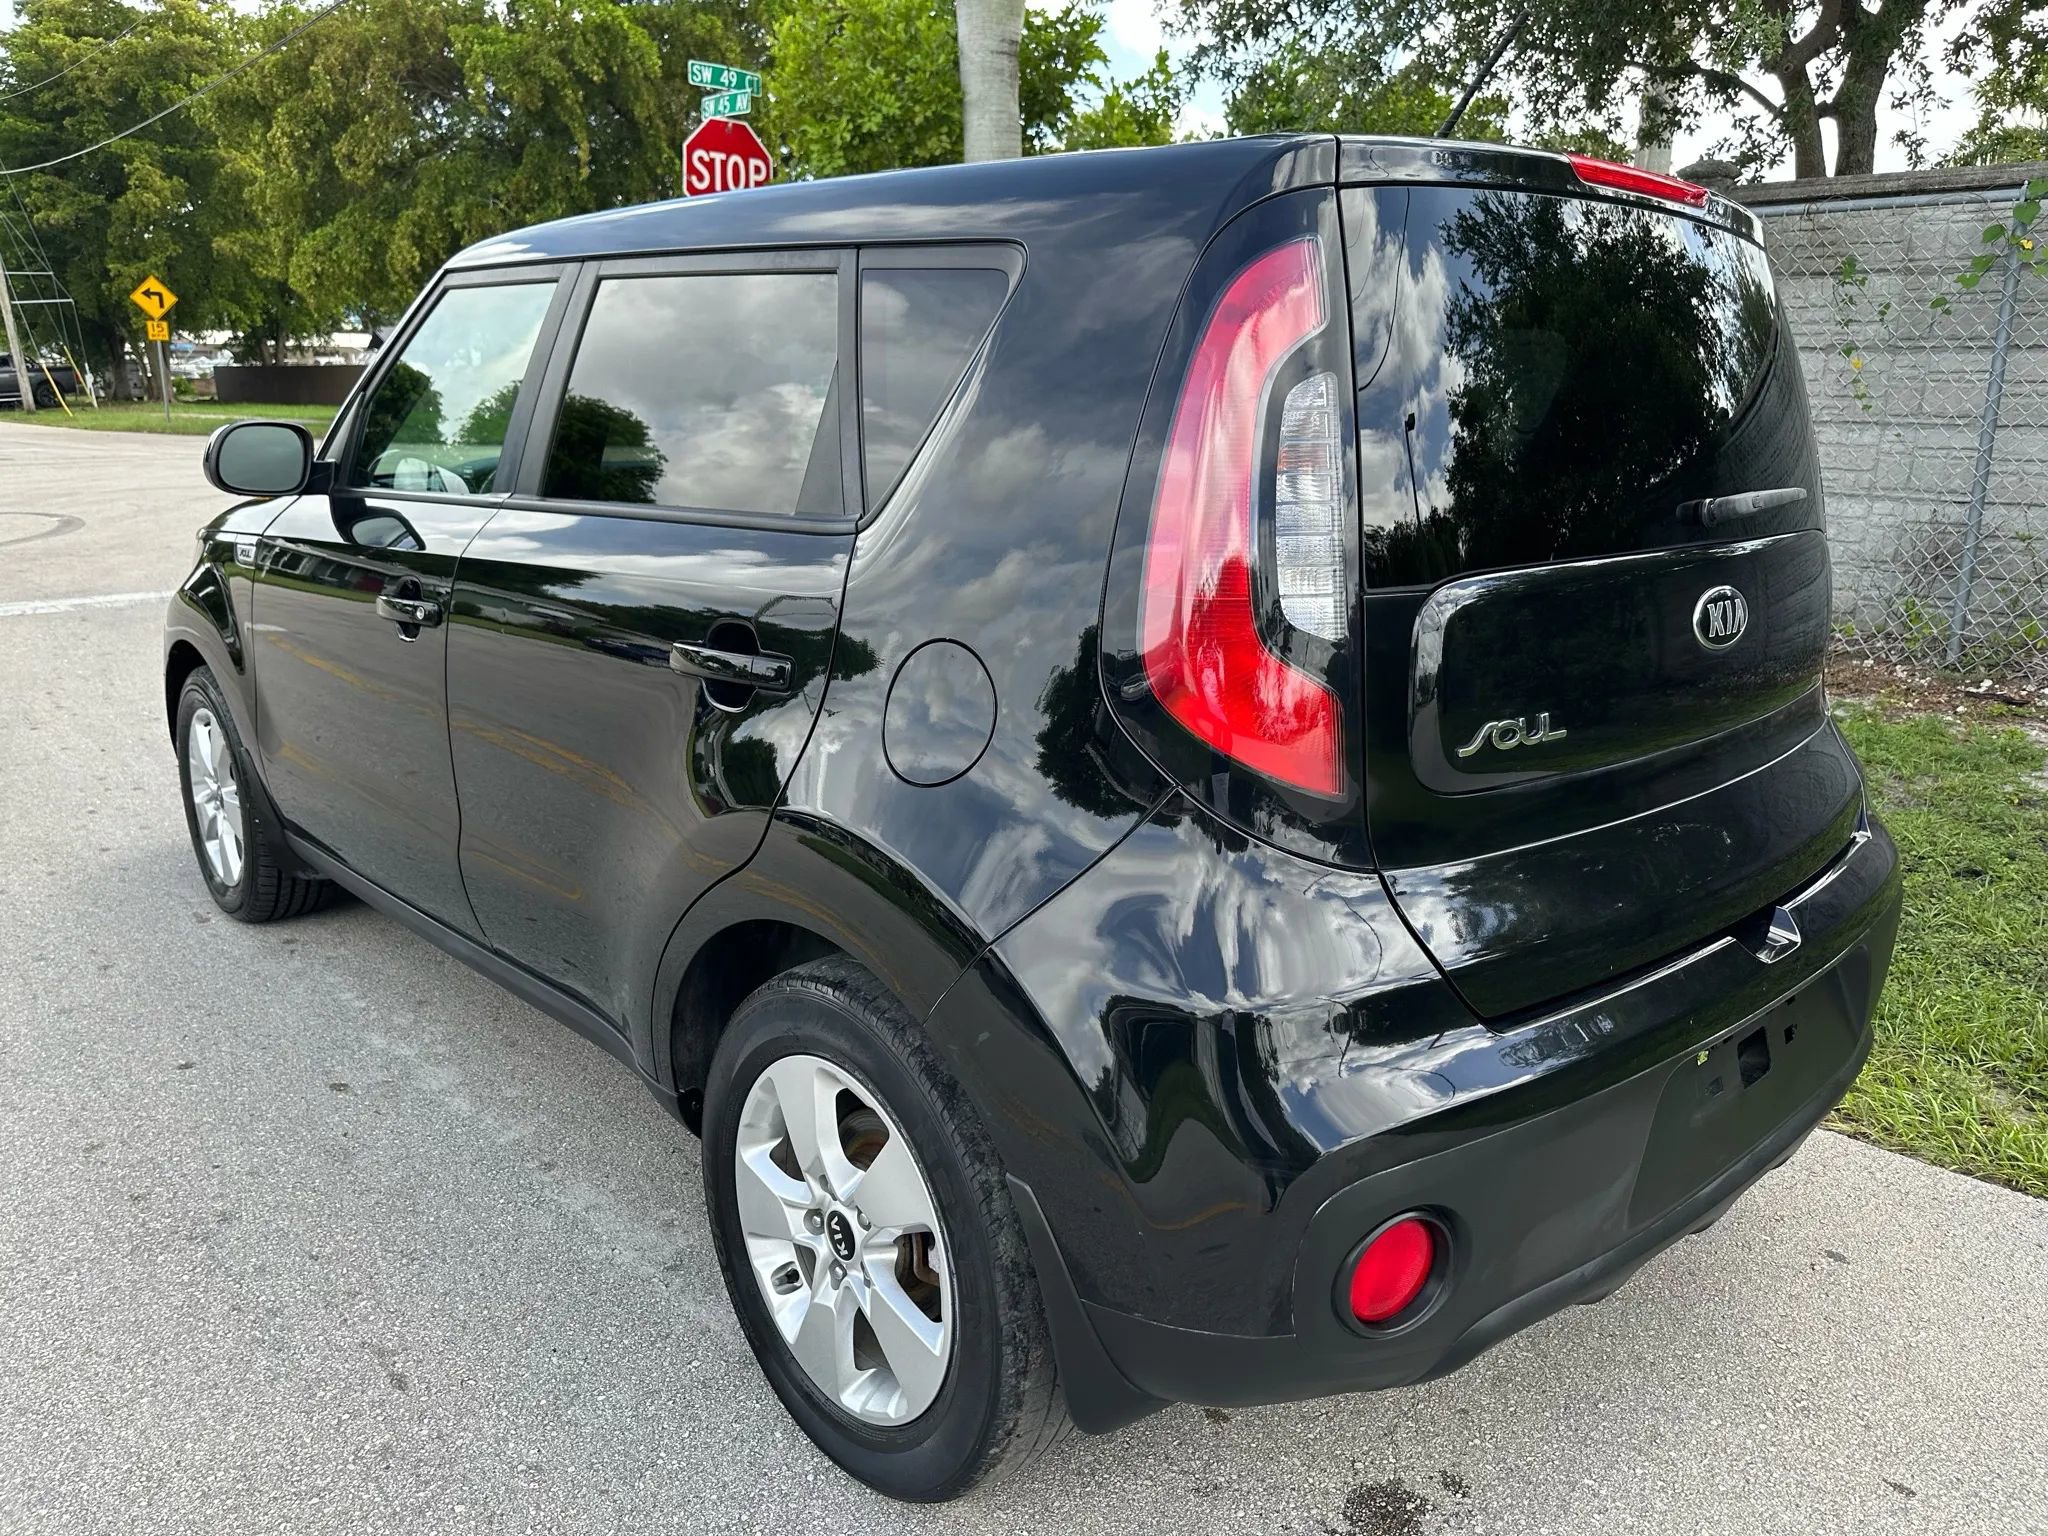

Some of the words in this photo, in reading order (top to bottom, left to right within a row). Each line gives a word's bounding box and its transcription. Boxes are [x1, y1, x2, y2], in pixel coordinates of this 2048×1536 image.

[692, 64, 712, 83] SW
[719, 70, 737, 88] 49
[745, 75, 759, 91] CT
[718, 96, 730, 114] 45
[736, 91, 748, 112] AV
[690, 149, 768, 192] STOP
[151, 323, 165, 333] 15
[1706, 598, 1745, 638] KIA
[1456, 712, 1568, 758] SOUL
[830, 1215, 849, 1256] KIA
